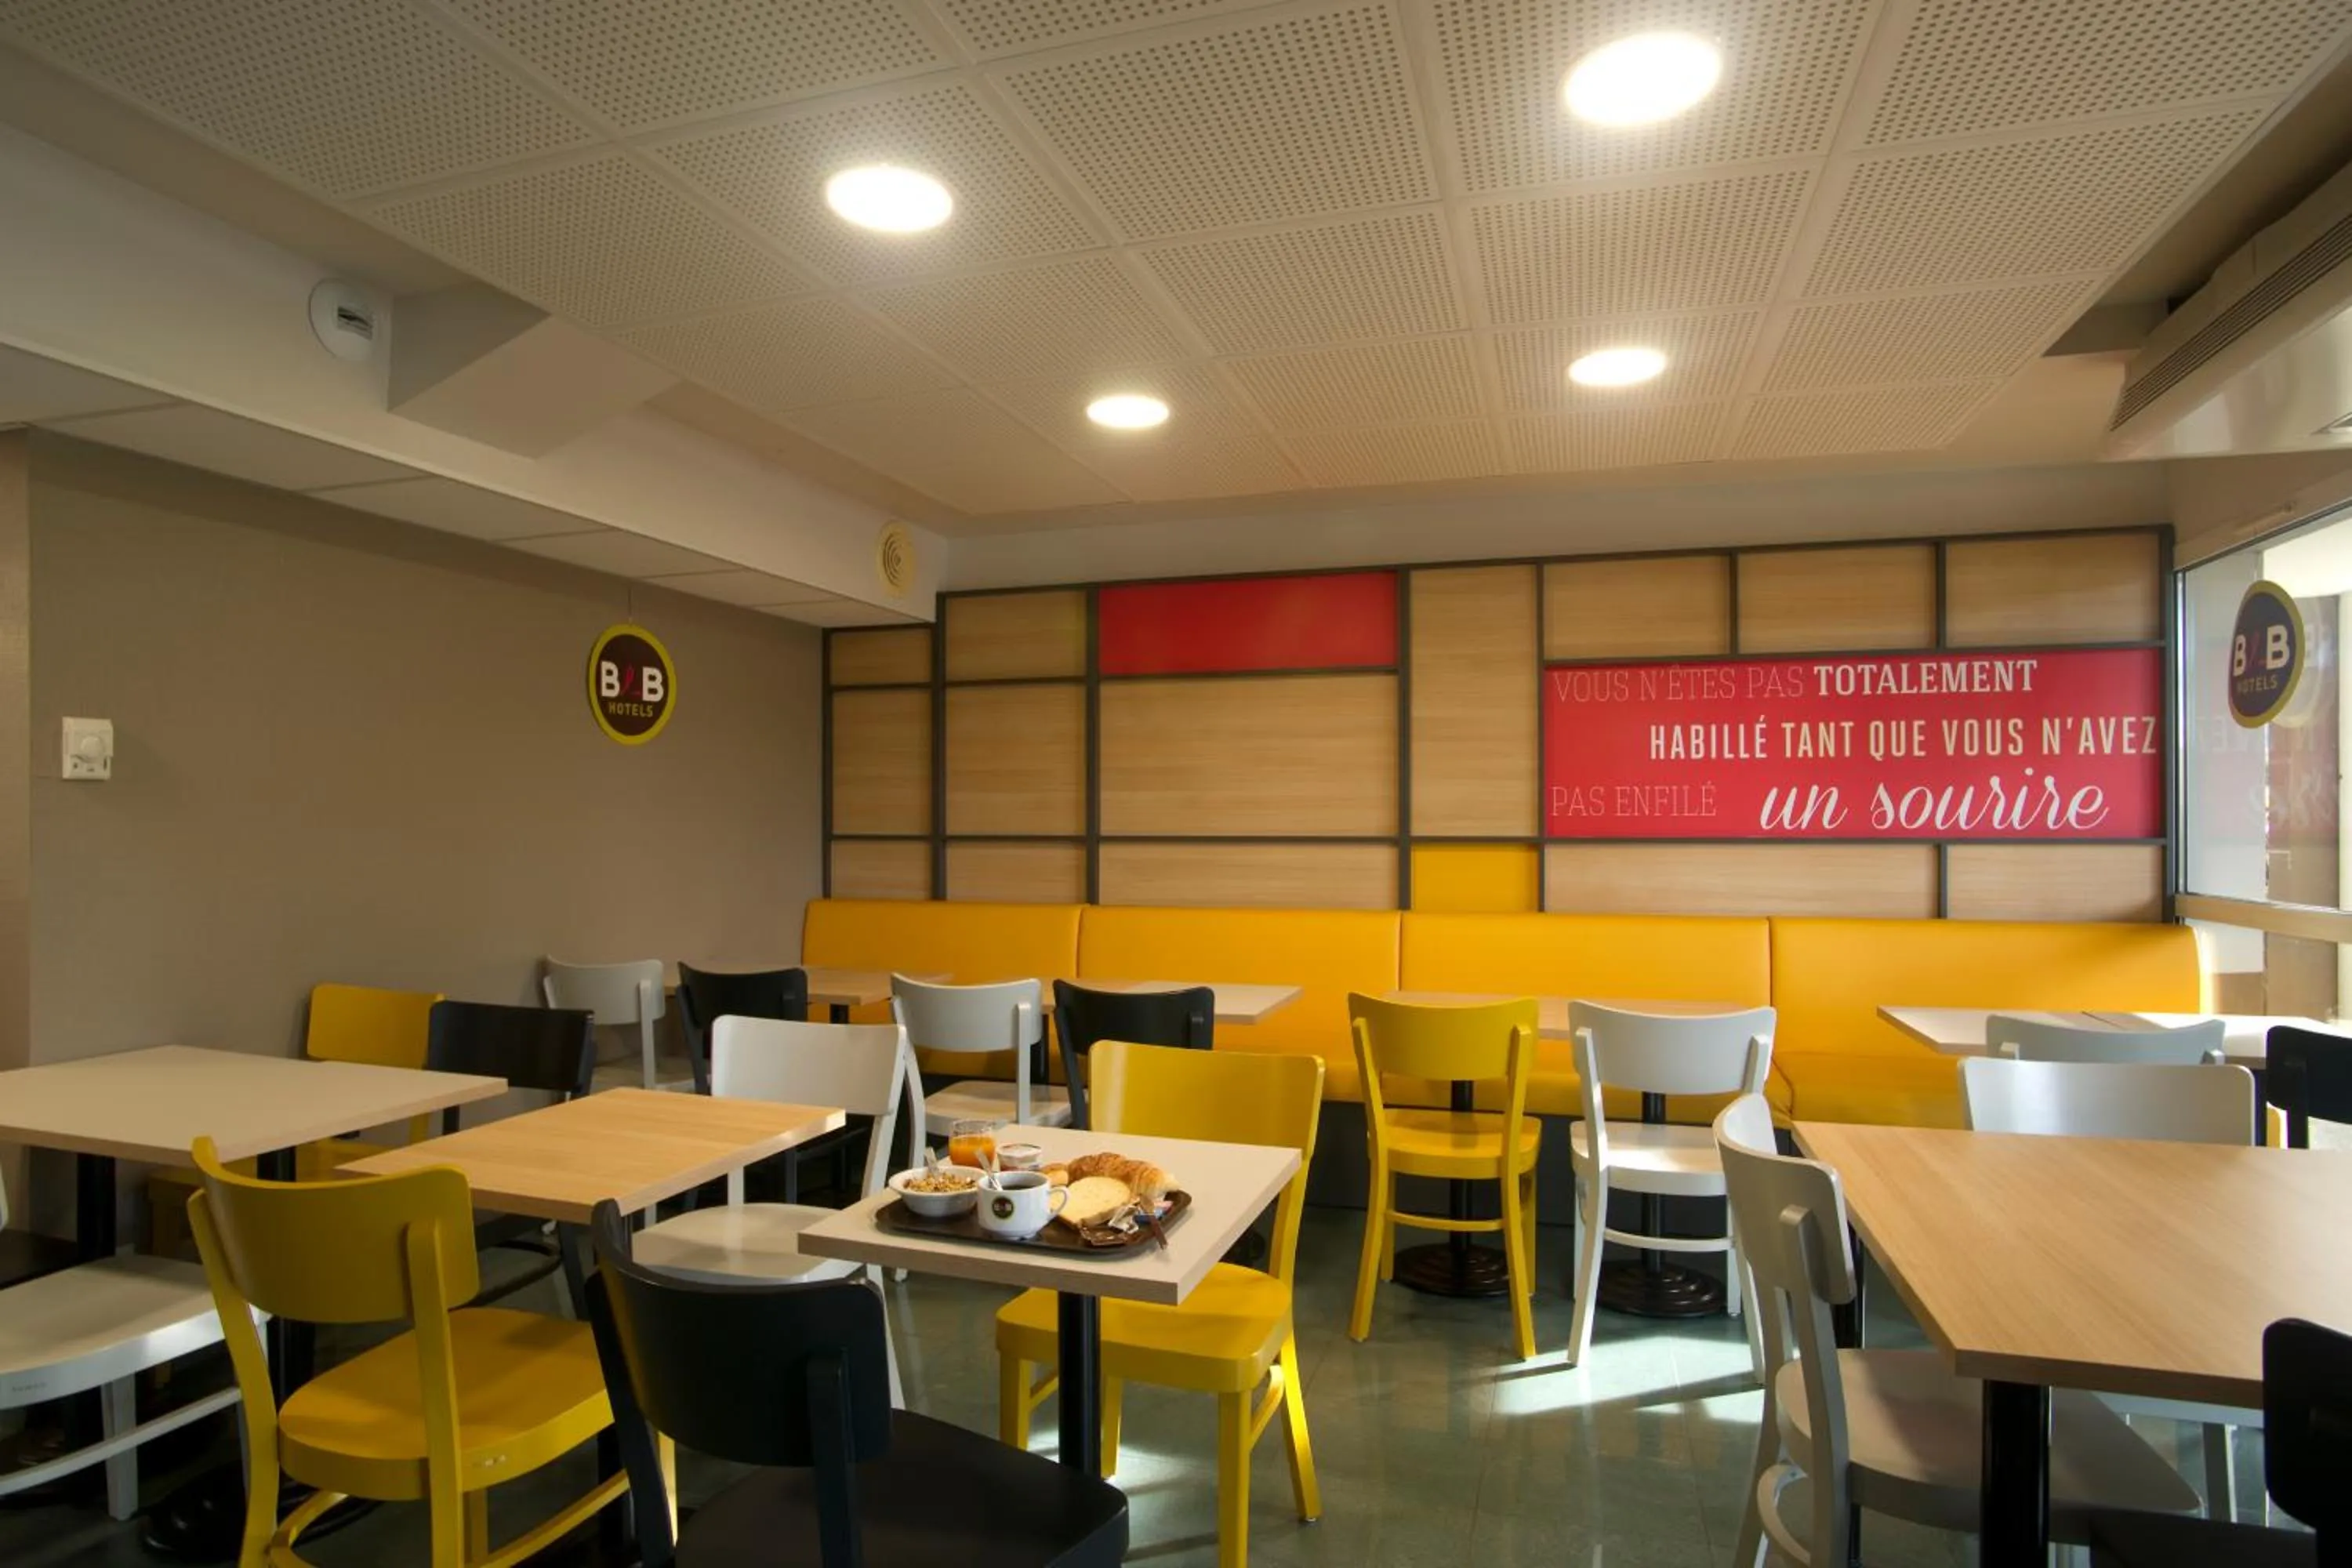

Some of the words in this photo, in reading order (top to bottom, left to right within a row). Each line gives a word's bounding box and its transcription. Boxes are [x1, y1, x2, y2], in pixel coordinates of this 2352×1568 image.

[1552, 670, 1629, 703] VOUS
[1639, 664, 1736, 701] N'ÊTES
[1747, 666, 1803, 699] PAS
[1813, 659, 2038, 696] TOTALEMENT
[608, 702, 653, 717] HOTELS
[1650, 714, 1768, 760] HABILLÉ
[1780, 721, 1855, 759] TANT
[1869, 720, 1926, 761] QUE
[1942, 718, 2024, 757] VOUS
[2042, 716, 2157, 755] N'AVEZ
[1550, 785, 1606, 817] PAS
[1613, 781, 1717, 817] ENFILÉ
[1759, 784, 1849, 830] un
[1870, 767, 2111, 831] sourire
